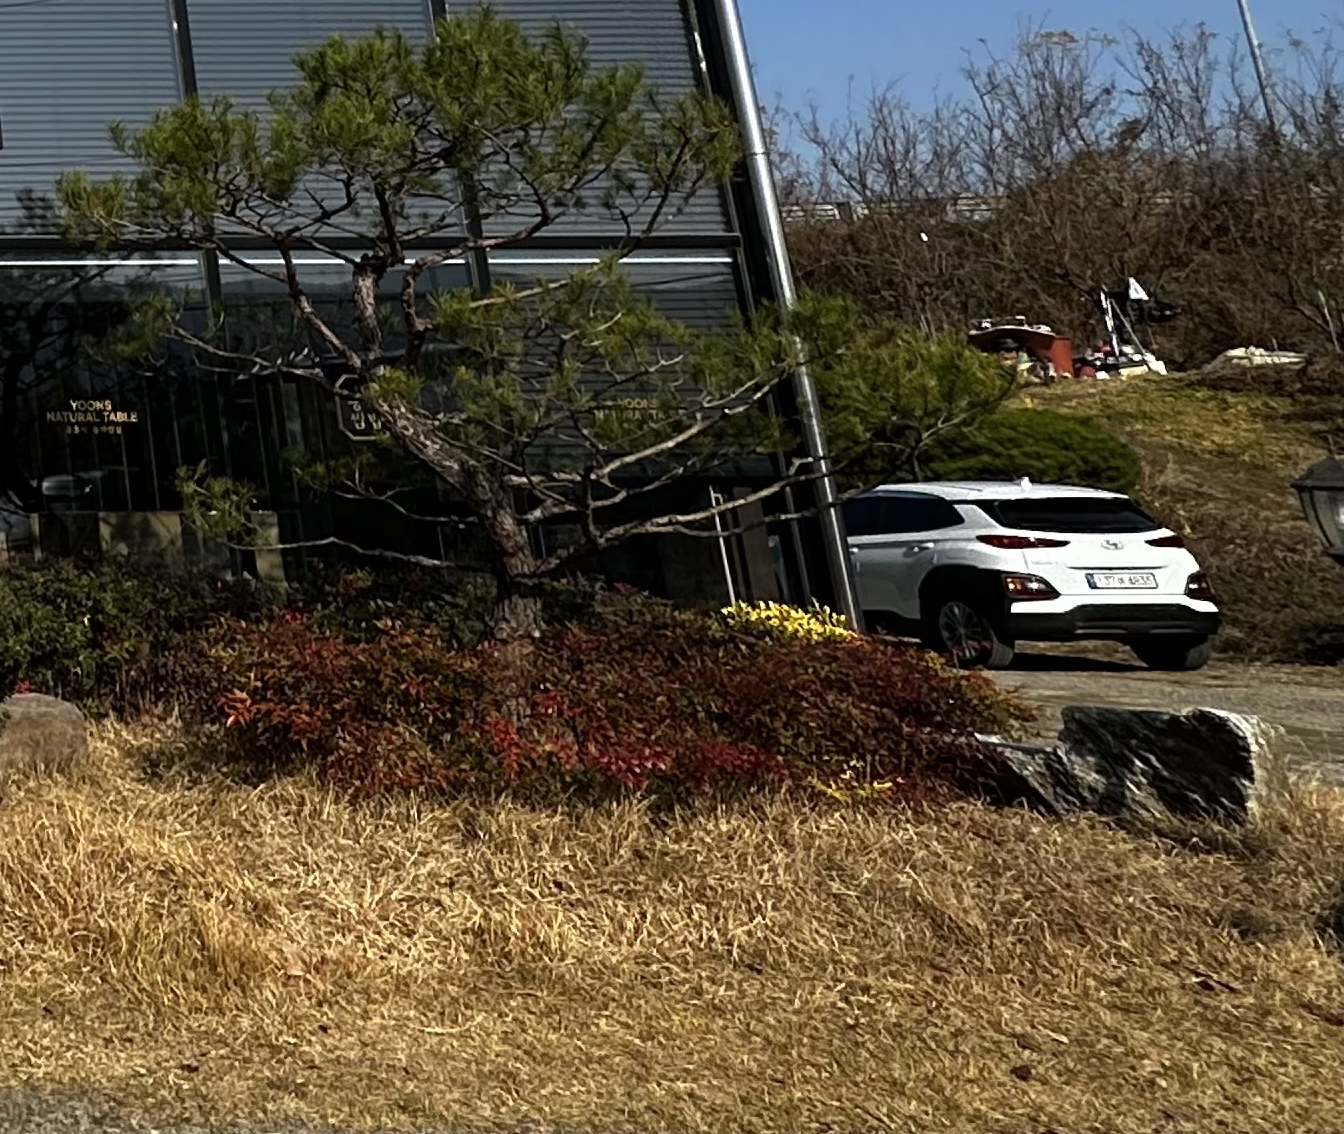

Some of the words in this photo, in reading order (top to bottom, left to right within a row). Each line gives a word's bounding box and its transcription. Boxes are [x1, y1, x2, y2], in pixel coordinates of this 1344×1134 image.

[69, 399, 112, 411] YOONS
[46, 411, 101, 422] NATURAL
[102, 411, 139, 422] TABLE
